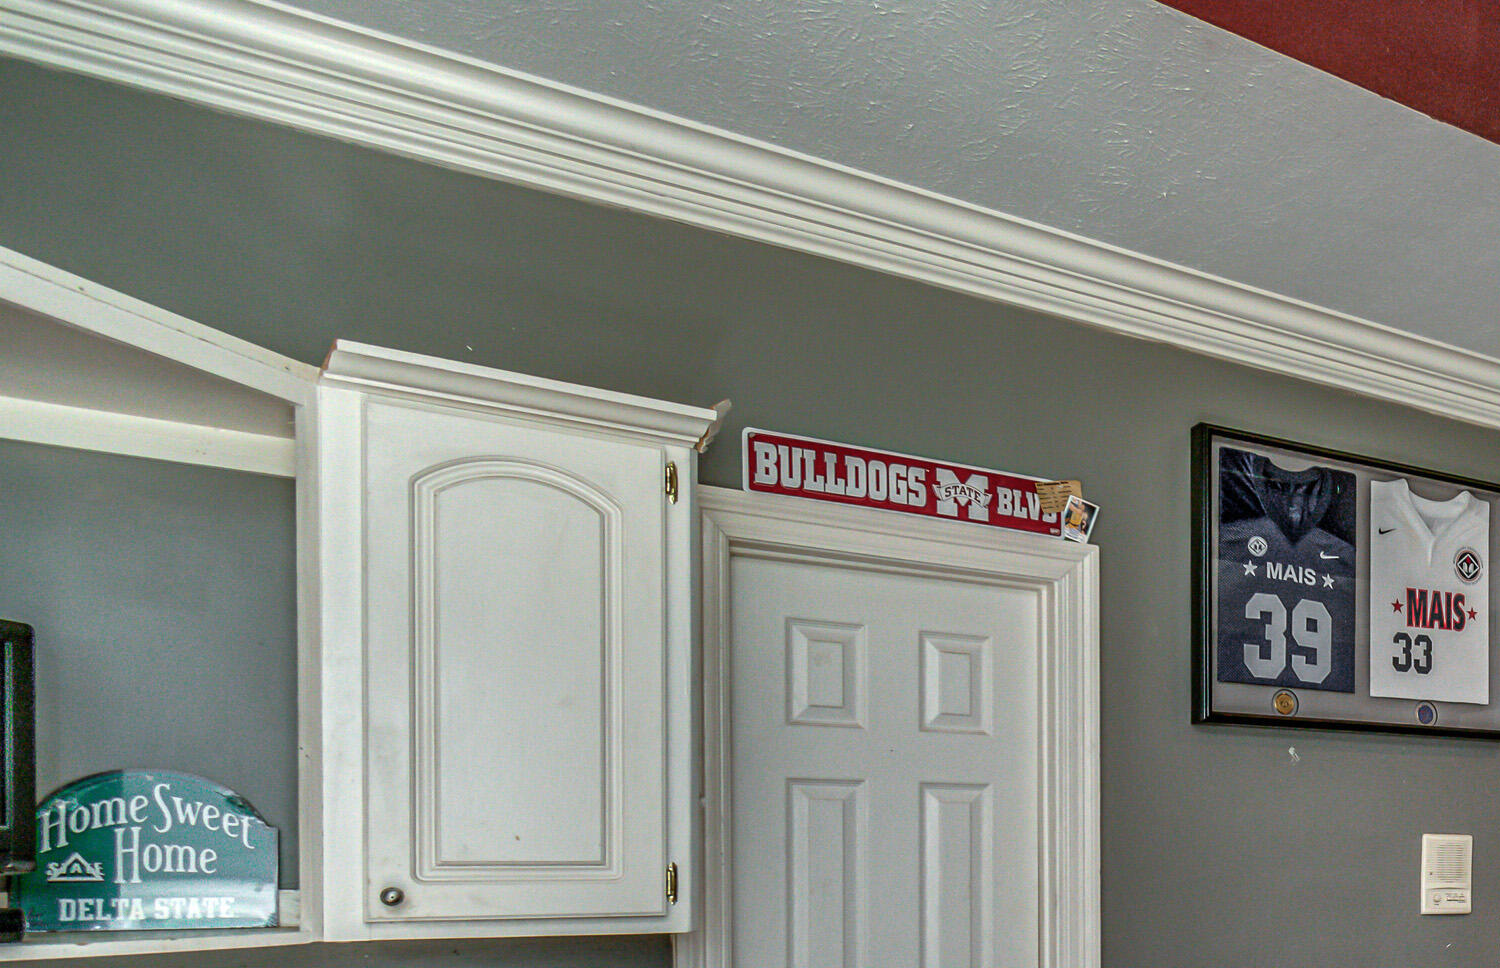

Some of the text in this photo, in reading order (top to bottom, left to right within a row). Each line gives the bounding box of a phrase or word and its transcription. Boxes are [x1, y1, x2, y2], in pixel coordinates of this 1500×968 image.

[753, 441, 929, 507] BULLDOGS
[944, 485, 982, 503] STATE
[1266, 561, 1317, 587] MAIS
[1406, 588, 1466, 632] MAIS
[1243, 592, 1332, 684] 39
[1392, 632, 1433, 675] 33
[37, 783, 255, 853] Home Sweet
[113, 826, 217, 884] Home
[58, 897, 145, 921] DELTA
[154, 896, 236, 920] STATE
